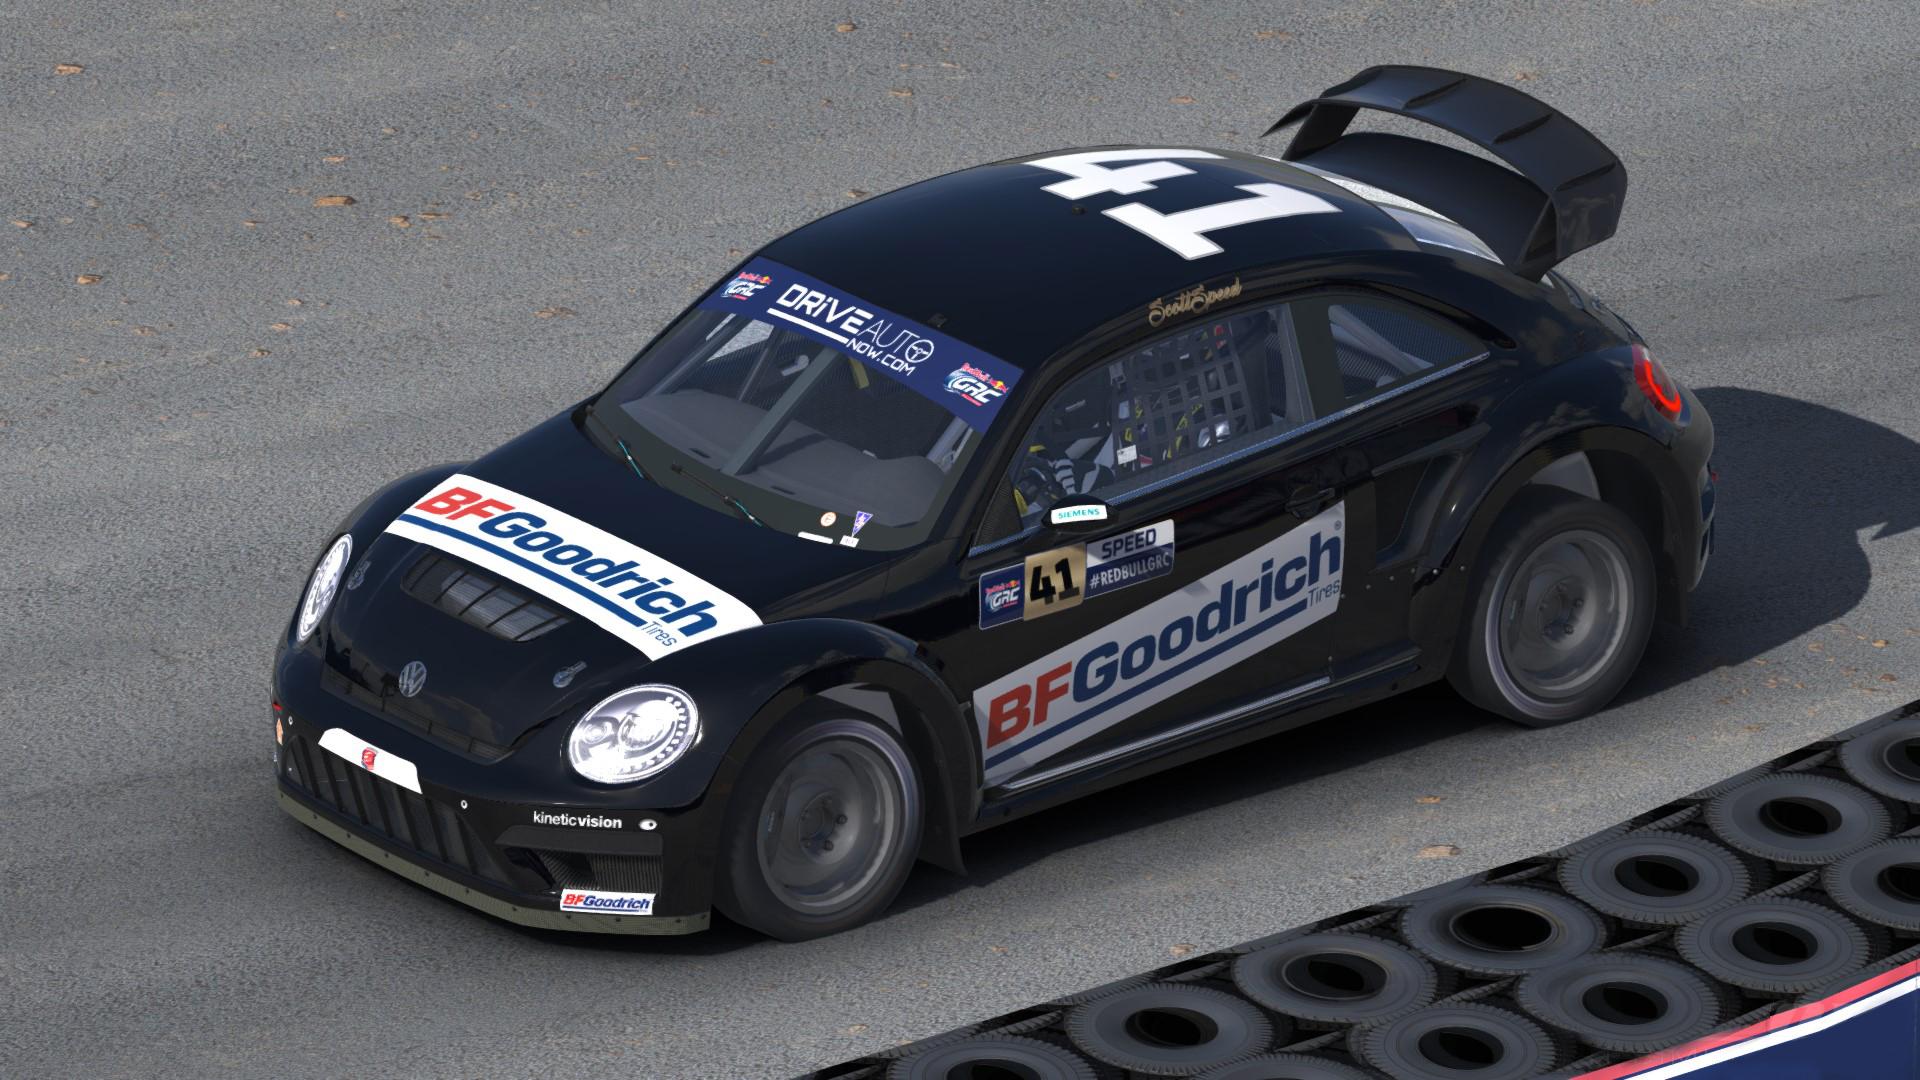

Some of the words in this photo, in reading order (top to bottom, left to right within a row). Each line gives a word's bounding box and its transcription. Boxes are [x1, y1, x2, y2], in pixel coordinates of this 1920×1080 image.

[1023, 148, 1343, 260] 41
[846, 338, 915, 376] NOW.COM
[951, 376, 1004, 404] GRC
[1058, 507, 1100, 519] SIEMENS
[1102, 528, 1157, 560] SPEED
[414, 486, 718, 638] BFGoodrich
[1089, 551, 1170, 590] #REDBULLGRC
[993, 586, 1021, 608] GRC
[1030, 558, 1080, 605] 41
[1309, 579, 1341, 607] Tires
[641, 620, 677, 647] Tires
[986, 531, 1343, 749] BFGoodrich
[563, 894, 650, 909] BFGoodrich
